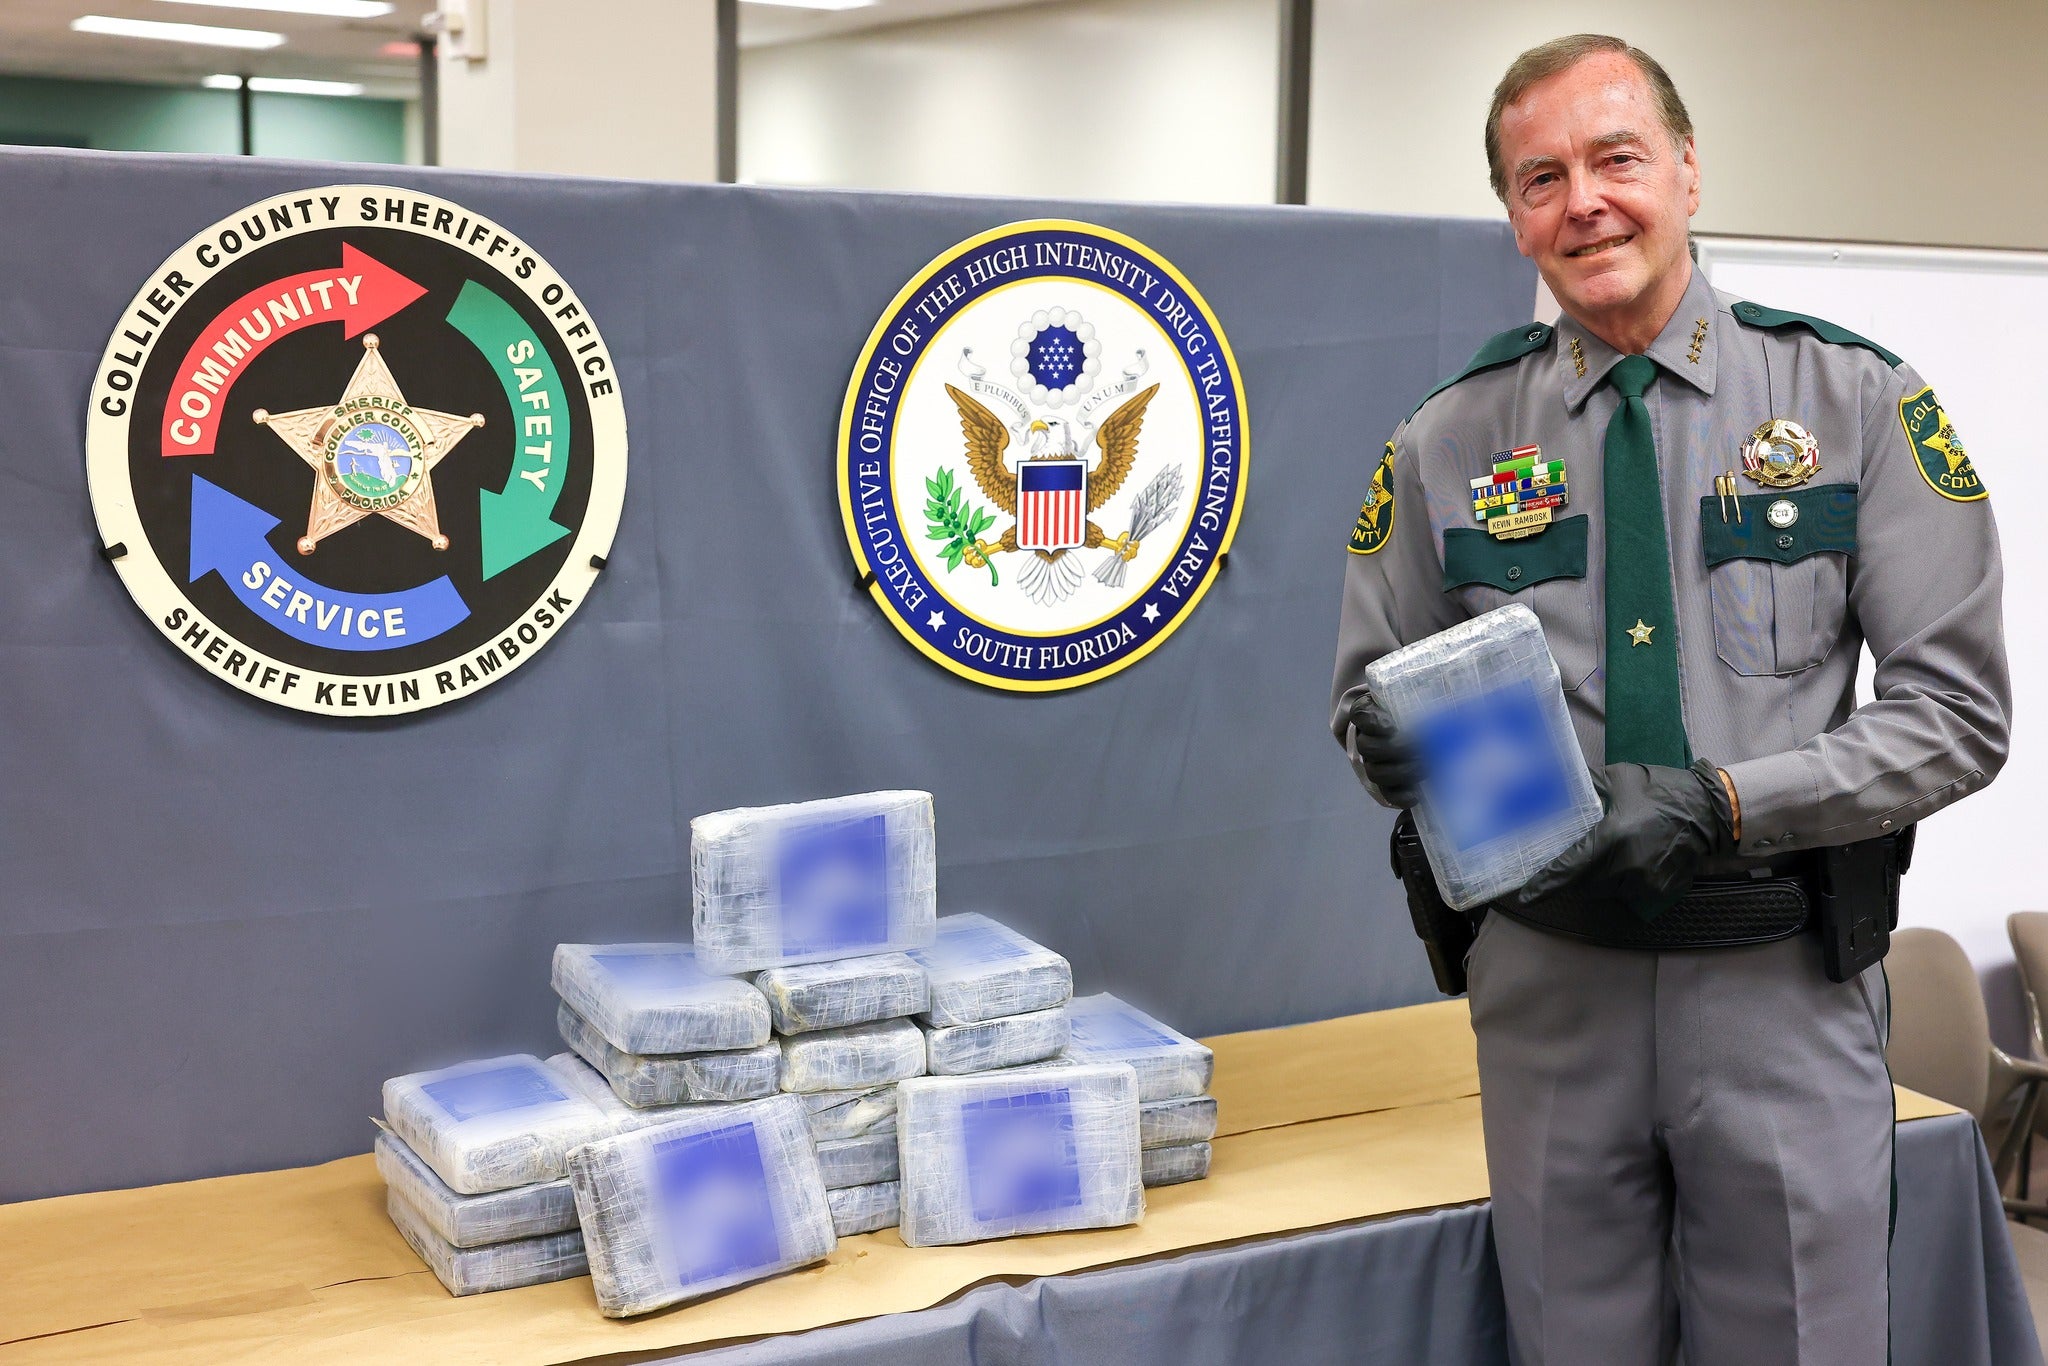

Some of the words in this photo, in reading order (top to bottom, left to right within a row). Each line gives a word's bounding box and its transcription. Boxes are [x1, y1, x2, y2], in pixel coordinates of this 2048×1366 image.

[963, 242, 1030, 287] HIGH
[1034, 241, 1160, 300] INTENSITY
[99, 269, 195, 418] COLLIER
[195, 195, 342, 269] COUNTY
[359, 196, 538, 280] SHERIFF'S
[541, 283, 614, 401] OFFICE
[914, 273, 967, 324] THE
[1152, 288, 1208, 356] DRUG
[169, 274, 363, 446] COMMUNITY
[891, 319, 918, 358] OF
[334, 397, 413, 418] SHERIFF
[505, 338, 554, 493] SAFETY
[860, 356, 903, 454] OFFICE
[974, 382, 980, 392] E
[984, 384, 1029, 419] PLURIBUS
[1083, 383, 1125, 412] UNUM
[325, 411, 375, 462] COLLIER
[381, 412, 423, 462] COUNTY
[1196, 352, 1232, 534] TRAFFICKING
[341, 488, 410, 511] FLORIDA
[1492, 520, 1511, 530] KEVIN
[1514, 512, 1548, 526] RAMBOSK
[858, 459, 928, 613] EXECUTIVE
[1159, 532, 1209, 599] AREA
[240, 559, 407, 638] SERVICE
[163, 606, 302, 696] SHERIFF
[313, 679, 421, 707] KEVIN
[435, 586, 573, 694] RAMBOSK
[952, 625, 1032, 671] SOUTH
[1038, 619, 1138, 670] FLORIDA
